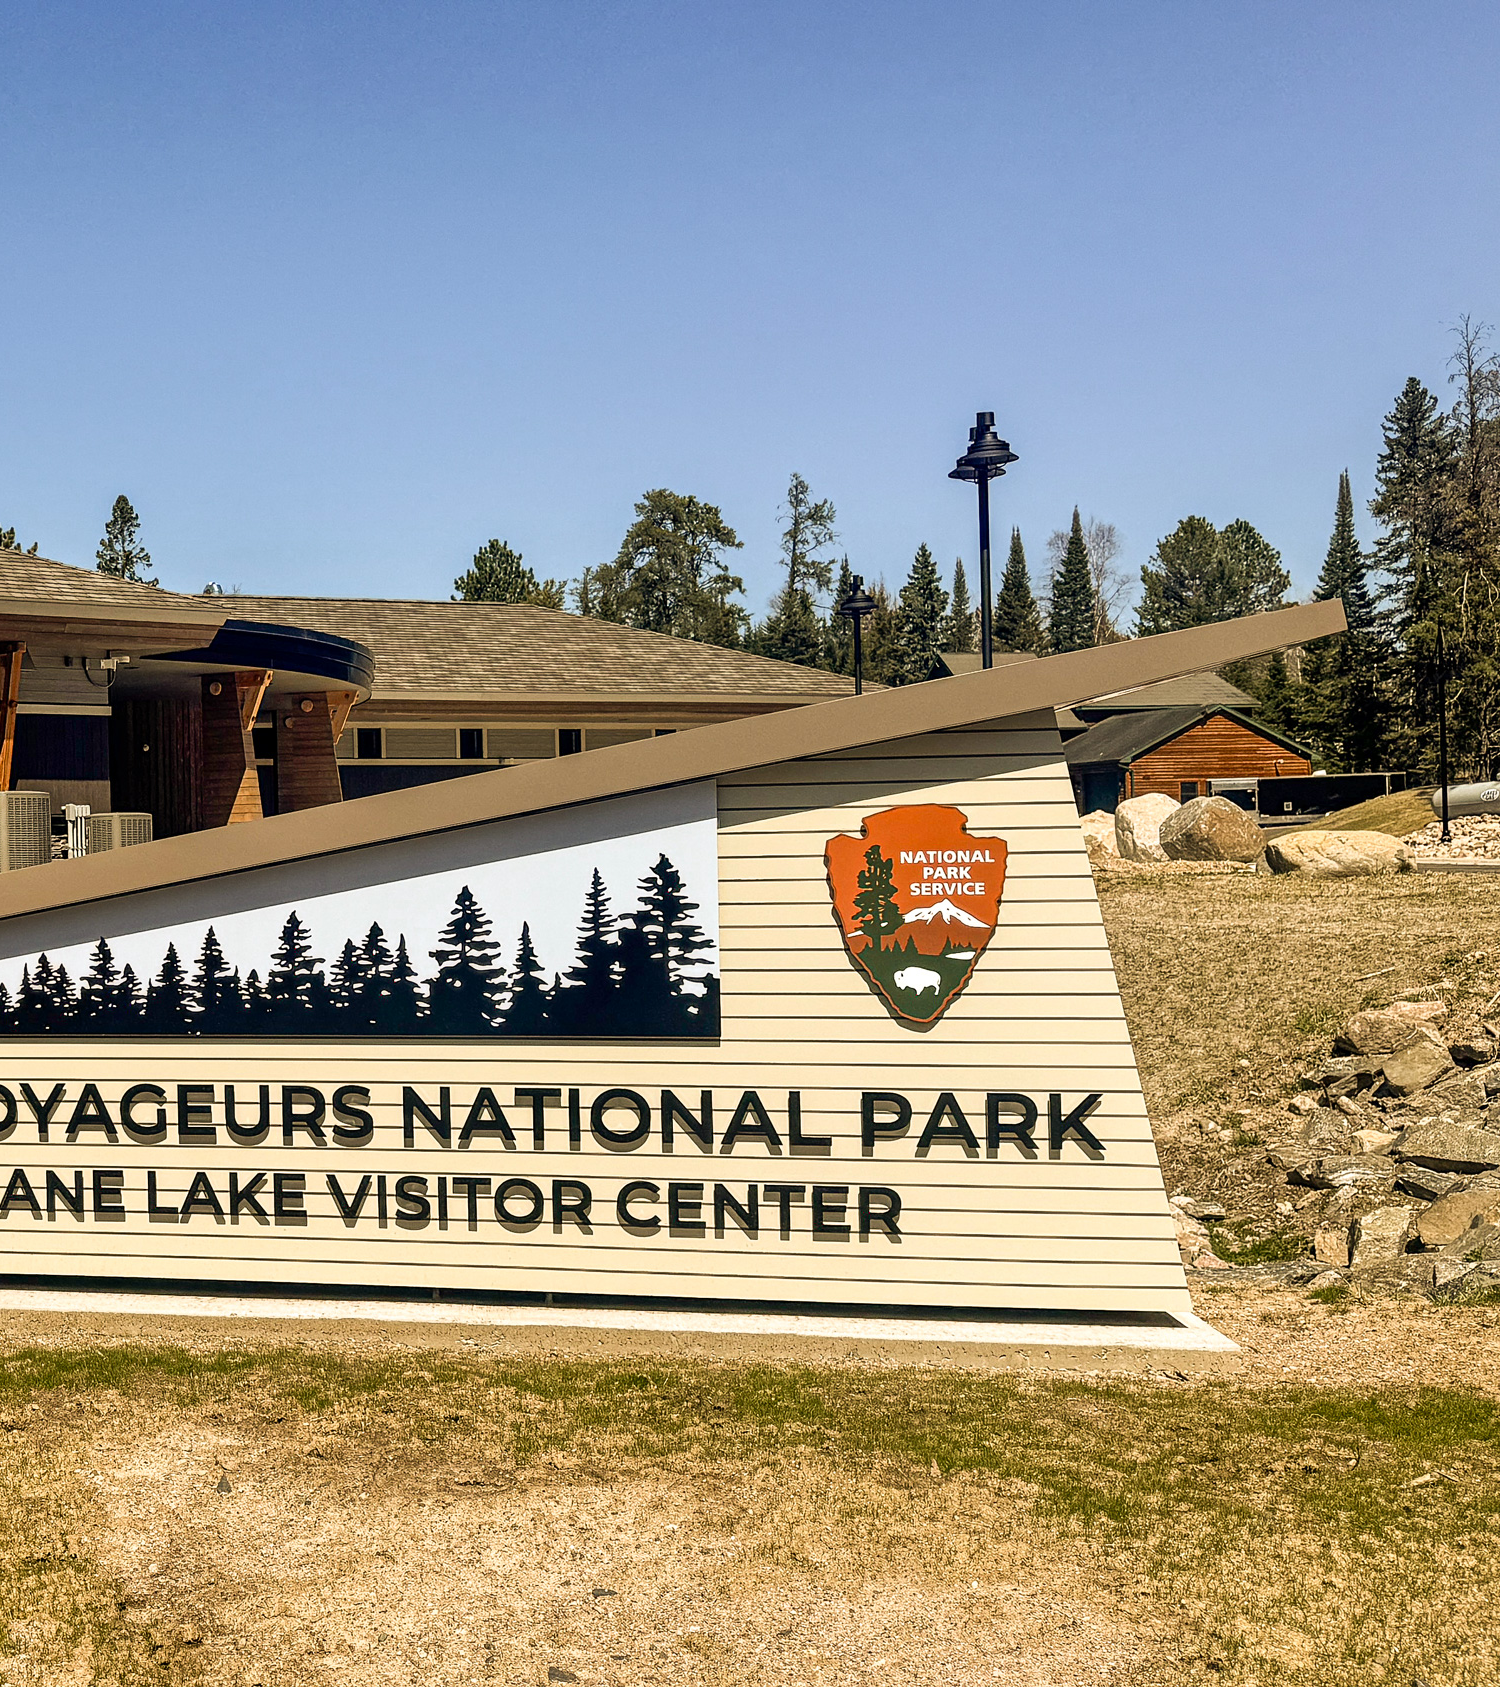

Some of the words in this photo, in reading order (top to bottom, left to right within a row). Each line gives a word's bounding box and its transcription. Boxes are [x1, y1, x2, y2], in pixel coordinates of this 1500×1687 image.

[900, 850, 995, 864] NATIONAL
[923, 866, 971, 880] PARK
[910, 882, 985, 896] SERVICE
[403, 1086, 832, 1147] NATIONAL
[862, 1092, 1104, 1151] PARK
[148, 1171, 307, 1218] LAKE
[327, 1175, 592, 1226] VISITOR
[617, 1181, 901, 1235] CENTER
